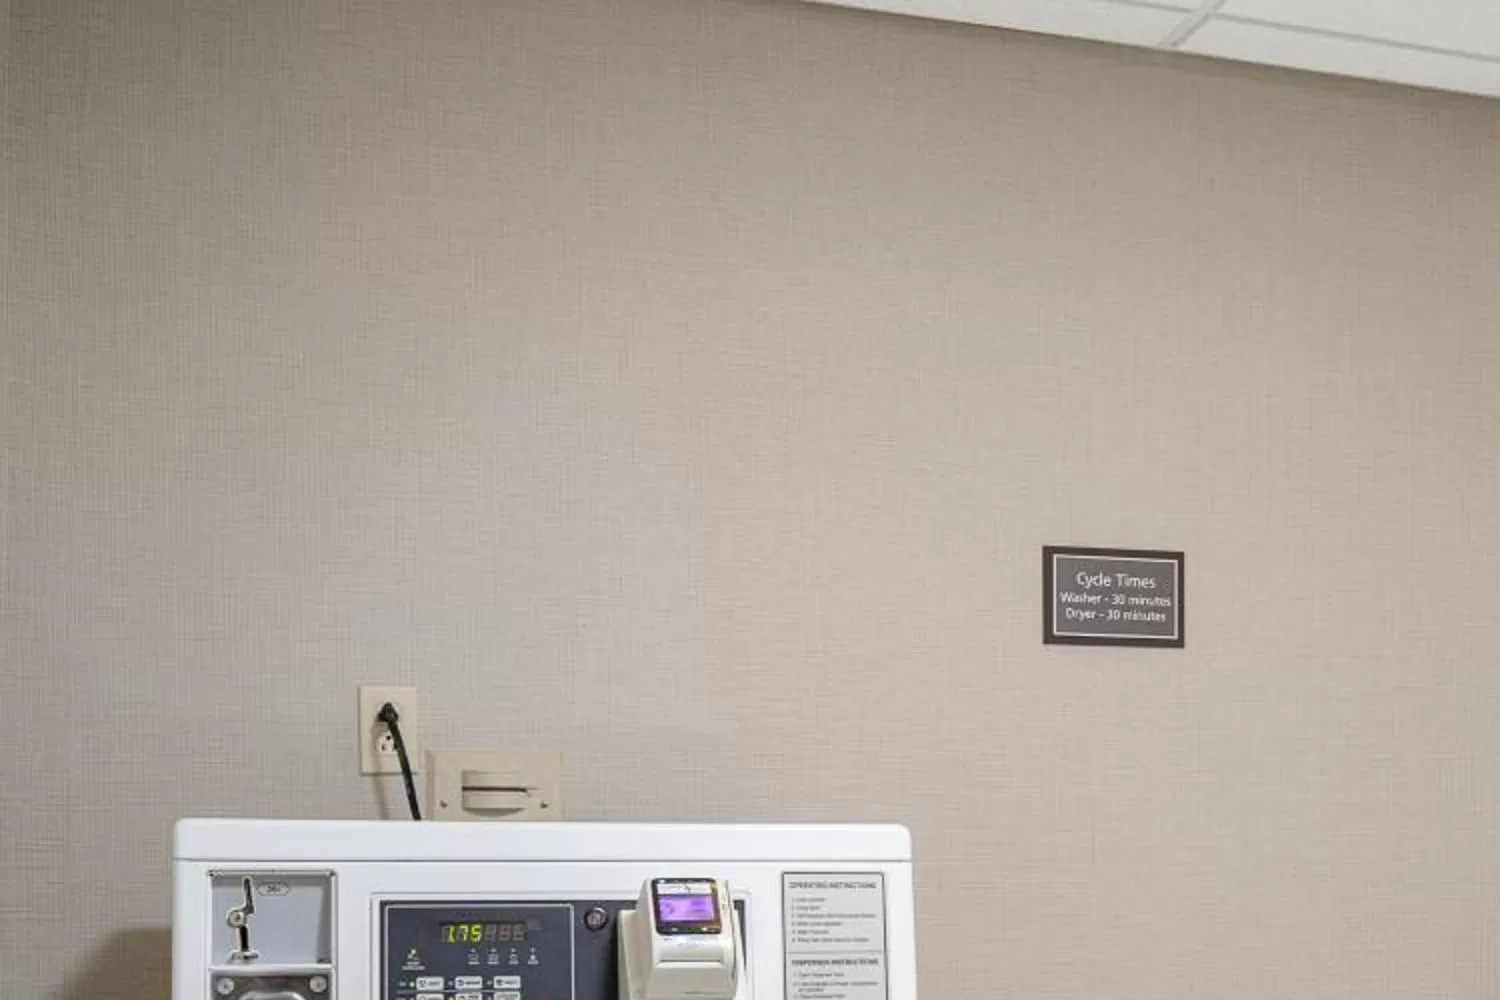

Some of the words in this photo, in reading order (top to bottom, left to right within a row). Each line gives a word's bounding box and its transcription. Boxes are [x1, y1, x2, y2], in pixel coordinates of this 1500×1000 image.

[1075, 571, 1112, 589] Cycle
[1115, 573, 1157, 589] Times
[1059, 591, 1102, 604] Washer
[1111, 593, 1125, 605] 30
[1127, 595, 1172, 607] minutes
[1065, 607, 1097, 621] Dryer
[1106, 609, 1121, 621] 30
[1123, 609, 1167, 622] minutes
